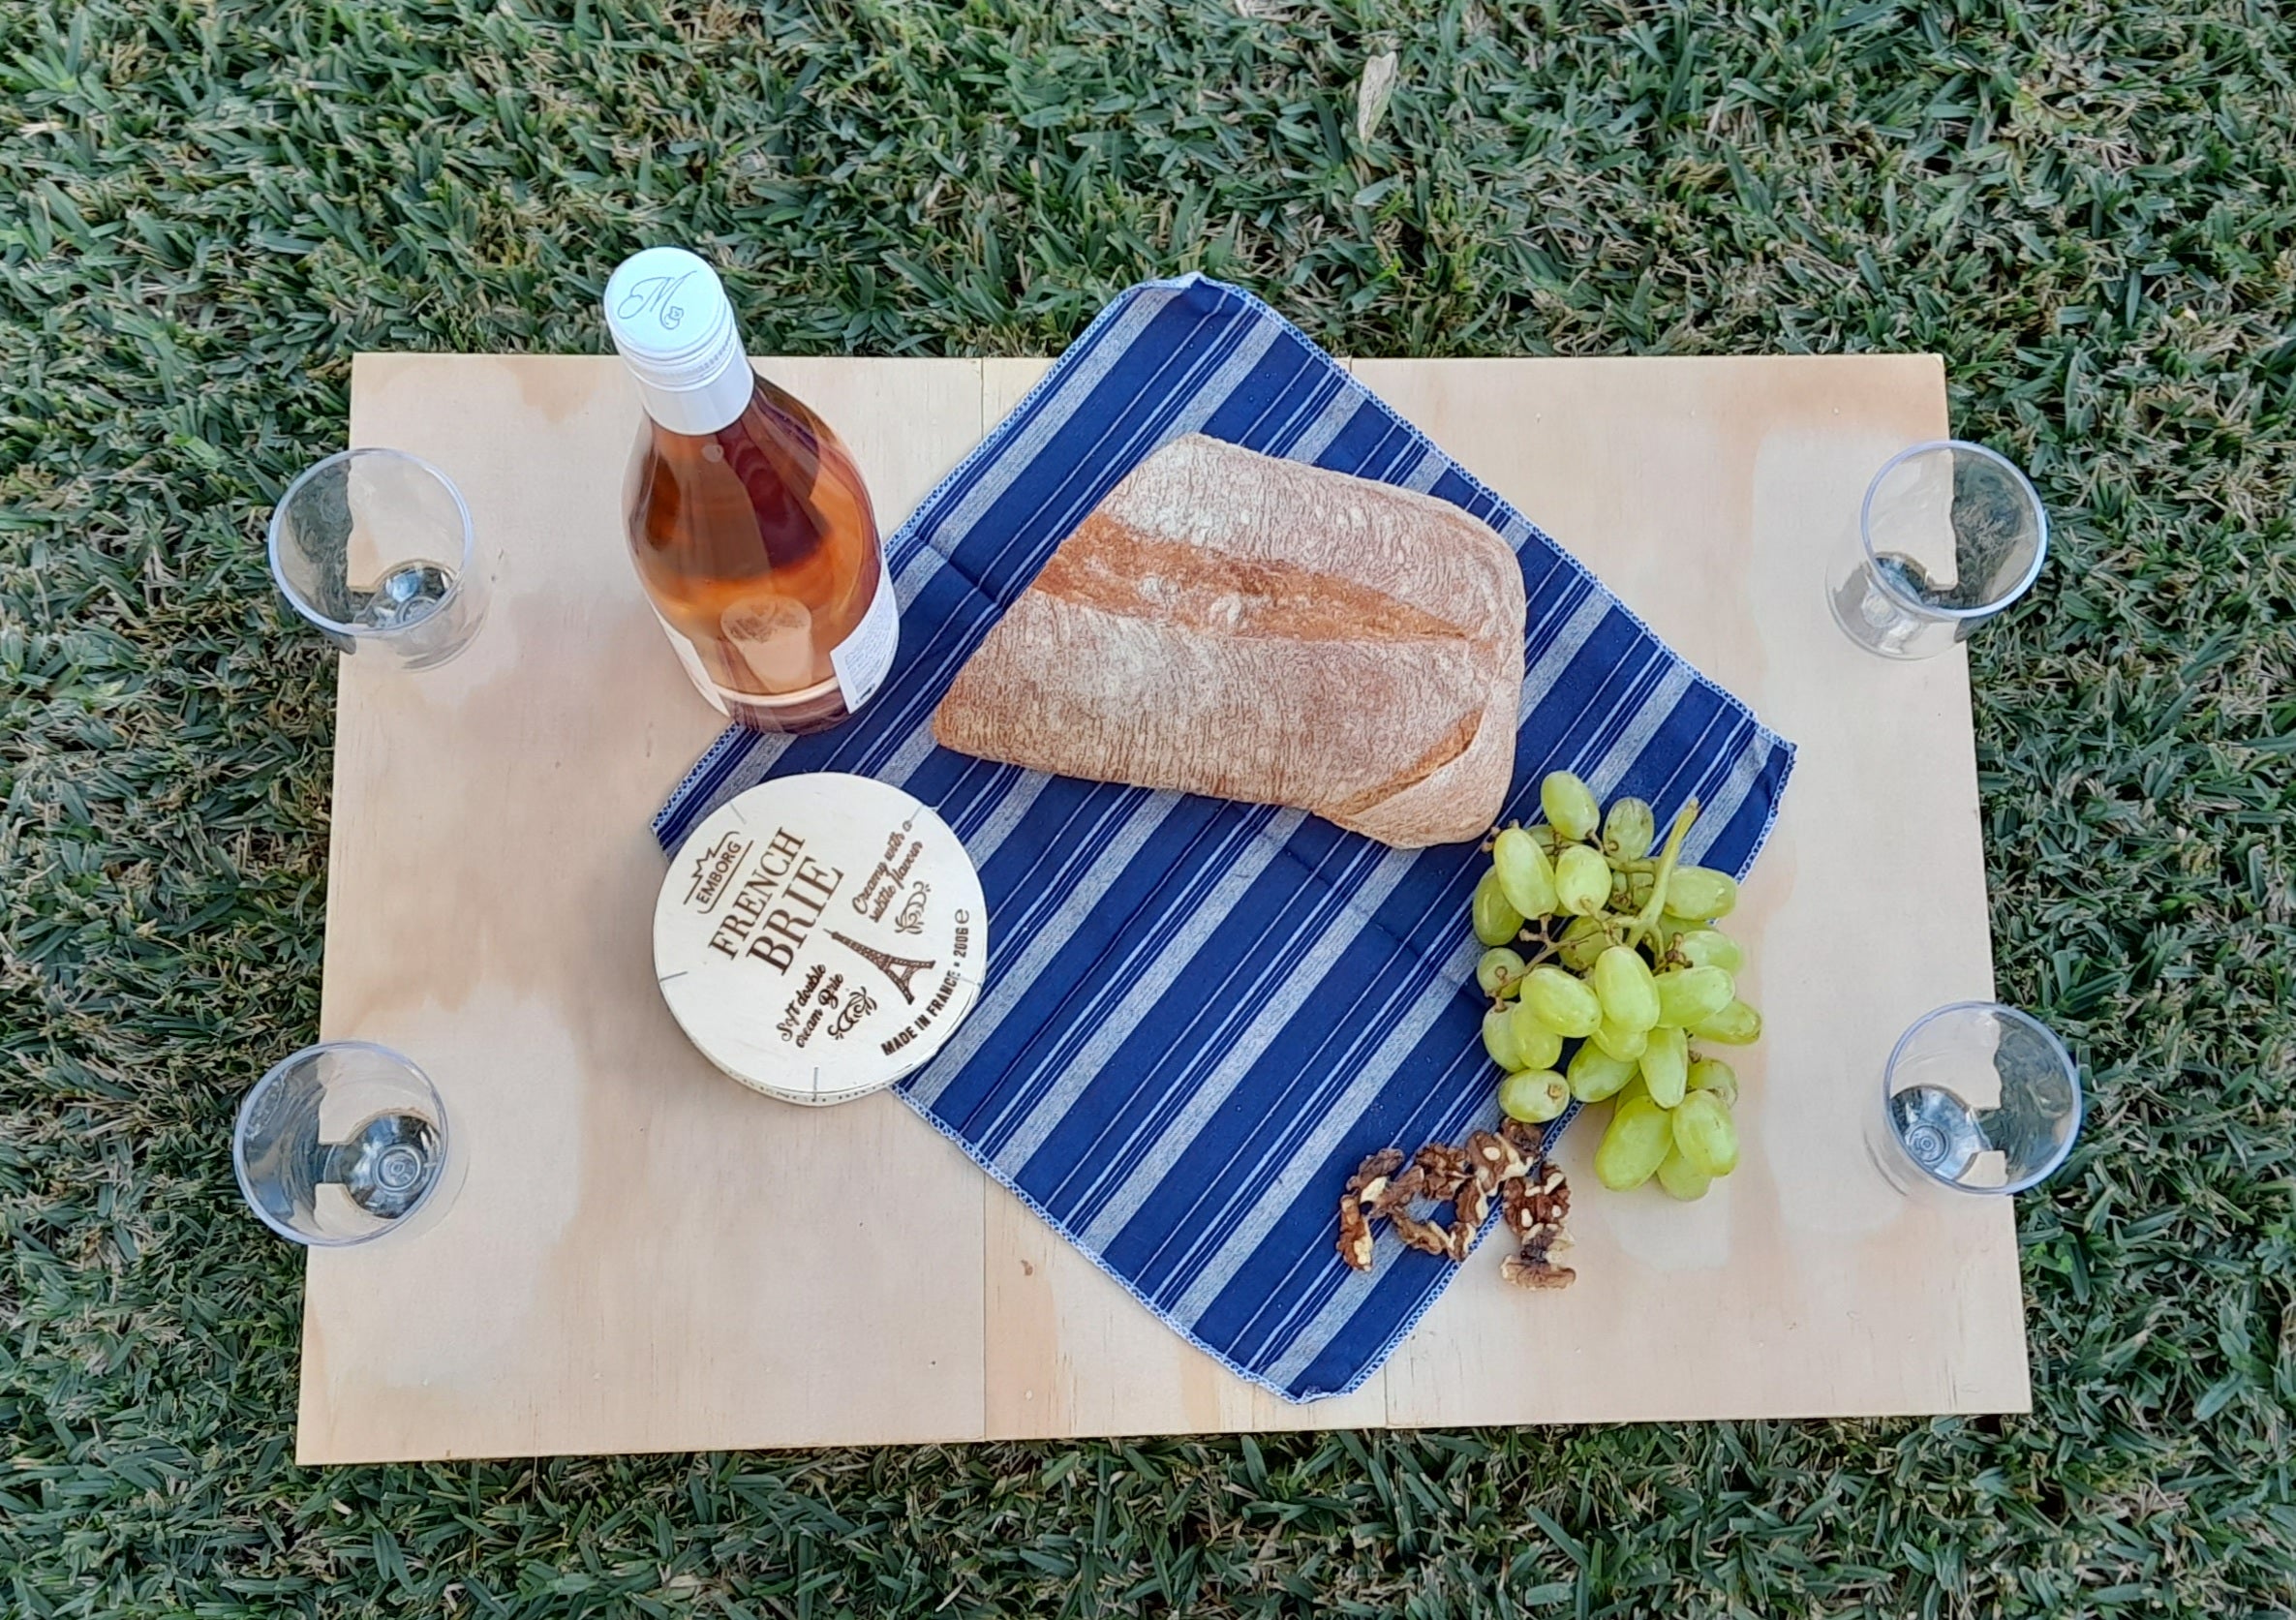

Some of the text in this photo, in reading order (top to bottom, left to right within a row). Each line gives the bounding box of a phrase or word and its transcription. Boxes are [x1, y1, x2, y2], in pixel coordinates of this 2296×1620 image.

[695, 841, 742, 904] EMBORG
[708, 827, 806, 961] FRENCH
[852, 820, 912, 915] Creamy with a
[869, 841, 923, 923] subtle flavour
[746, 856, 844, 976] BRIE
[776, 963, 827, 1042] Soft double
[795, 972, 844, 1049] cream Brie
[880, 1025, 917, 1055] MADE
[913, 1014, 932, 1031] IN
[926, 969, 962, 1019] FRANCE
